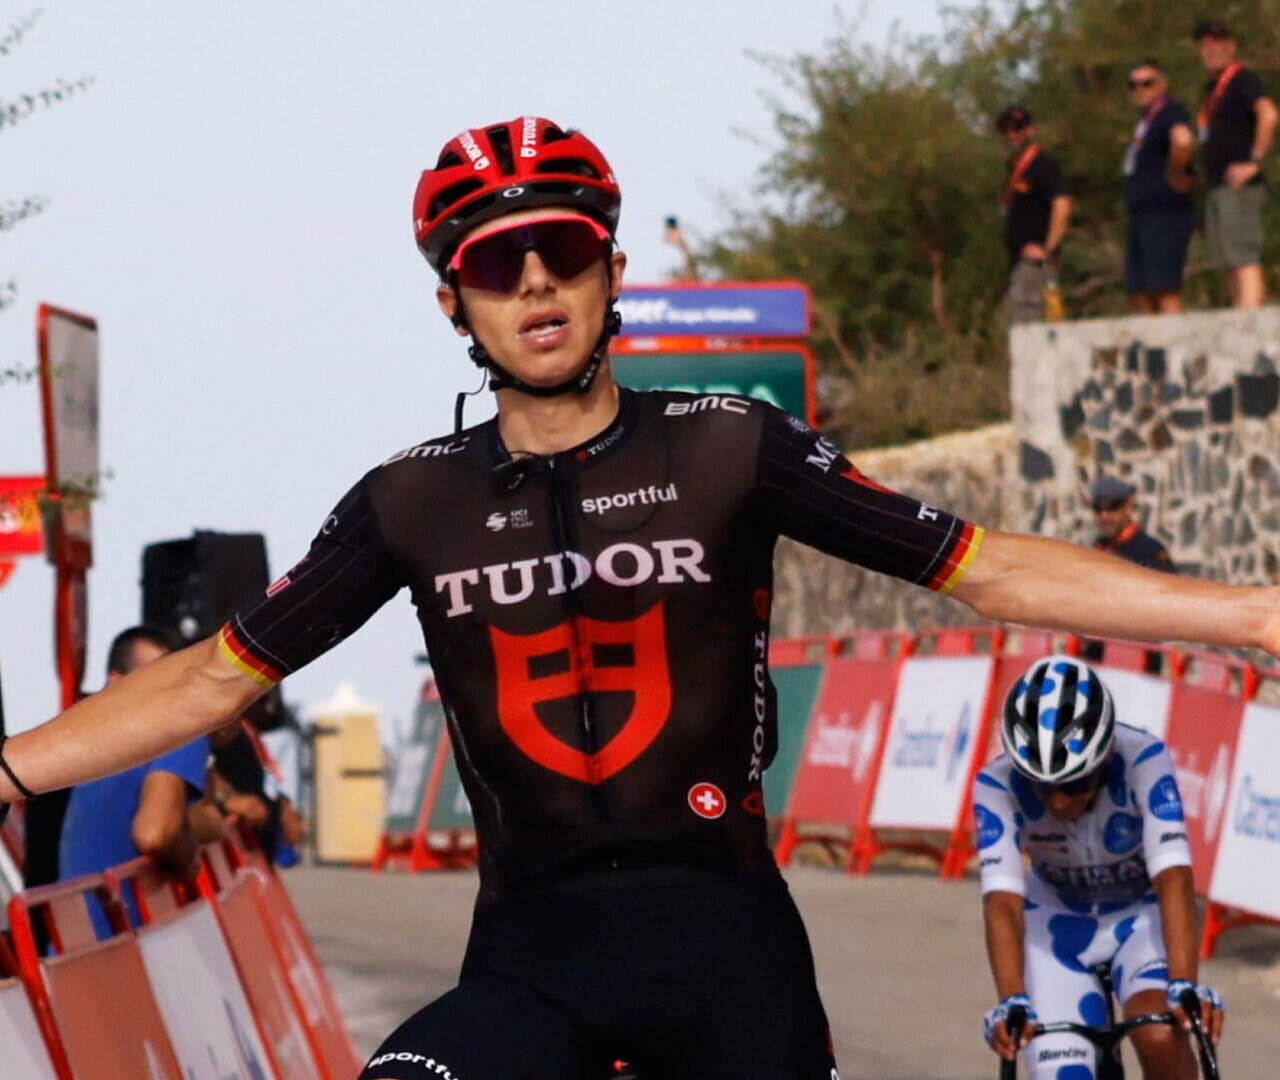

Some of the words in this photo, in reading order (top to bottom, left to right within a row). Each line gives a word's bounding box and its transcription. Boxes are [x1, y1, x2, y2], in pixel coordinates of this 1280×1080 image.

[664, 395, 752, 416] BMC
[582, 483, 678, 515] sportful
[434, 538, 711, 618] TUDOR
[748, 630, 767, 782] TUDOR
